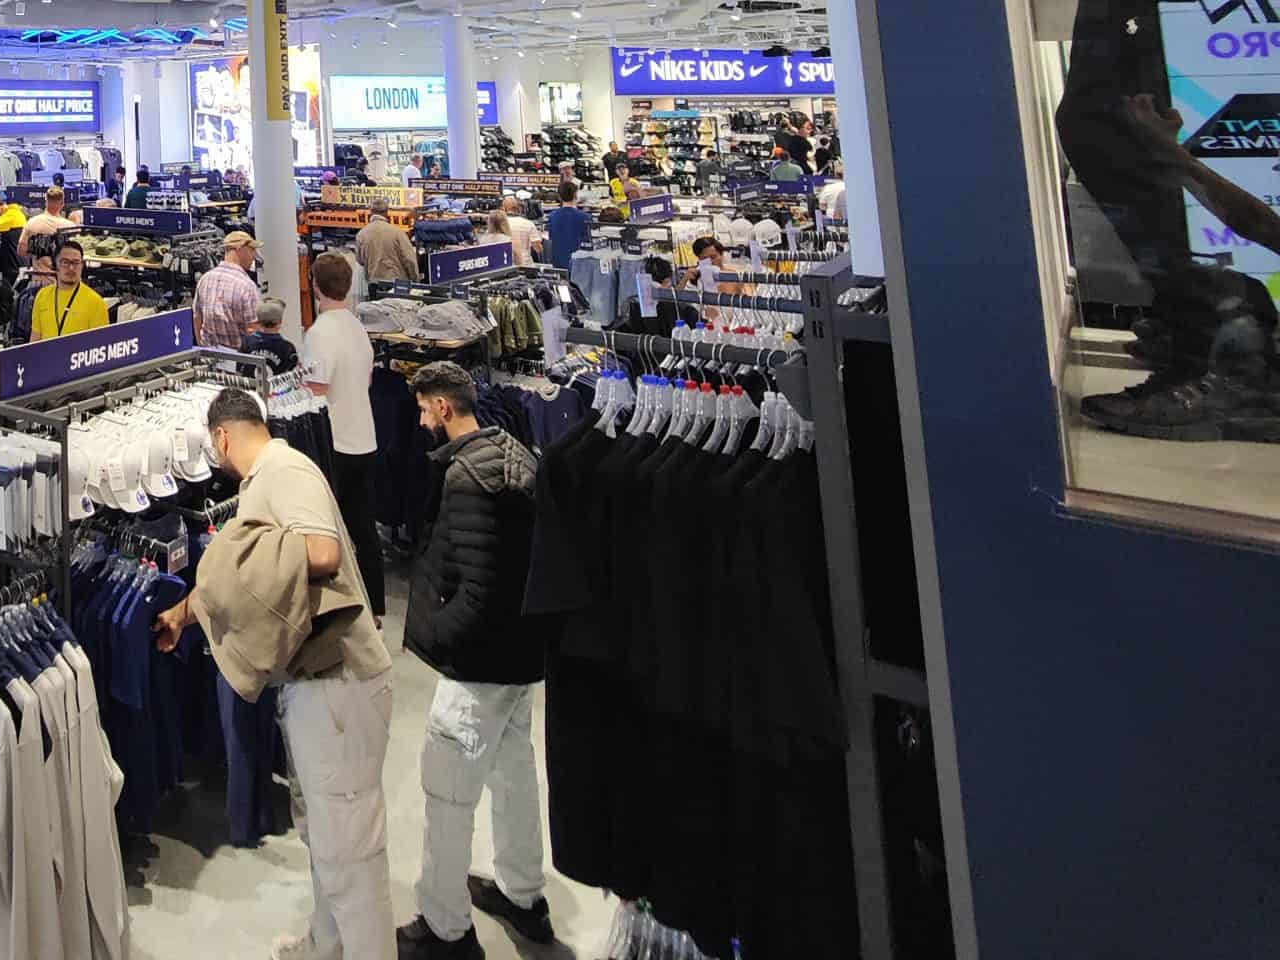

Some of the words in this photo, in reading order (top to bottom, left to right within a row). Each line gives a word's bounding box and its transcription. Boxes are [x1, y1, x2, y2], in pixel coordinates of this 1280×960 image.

[650, 59, 698, 81] NIKE
[700, 60, 745, 81] KIDS
[798, 61, 836, 82] SPU
[14, 98, 38, 114] ONE
[38, 99, 65, 113] HALF
[65, 98, 94, 114] PRICE
[364, 87, 420, 110] LONDON
[70, 345, 107, 371] SPURS
[107, 337, 139, 361] MEN'S
